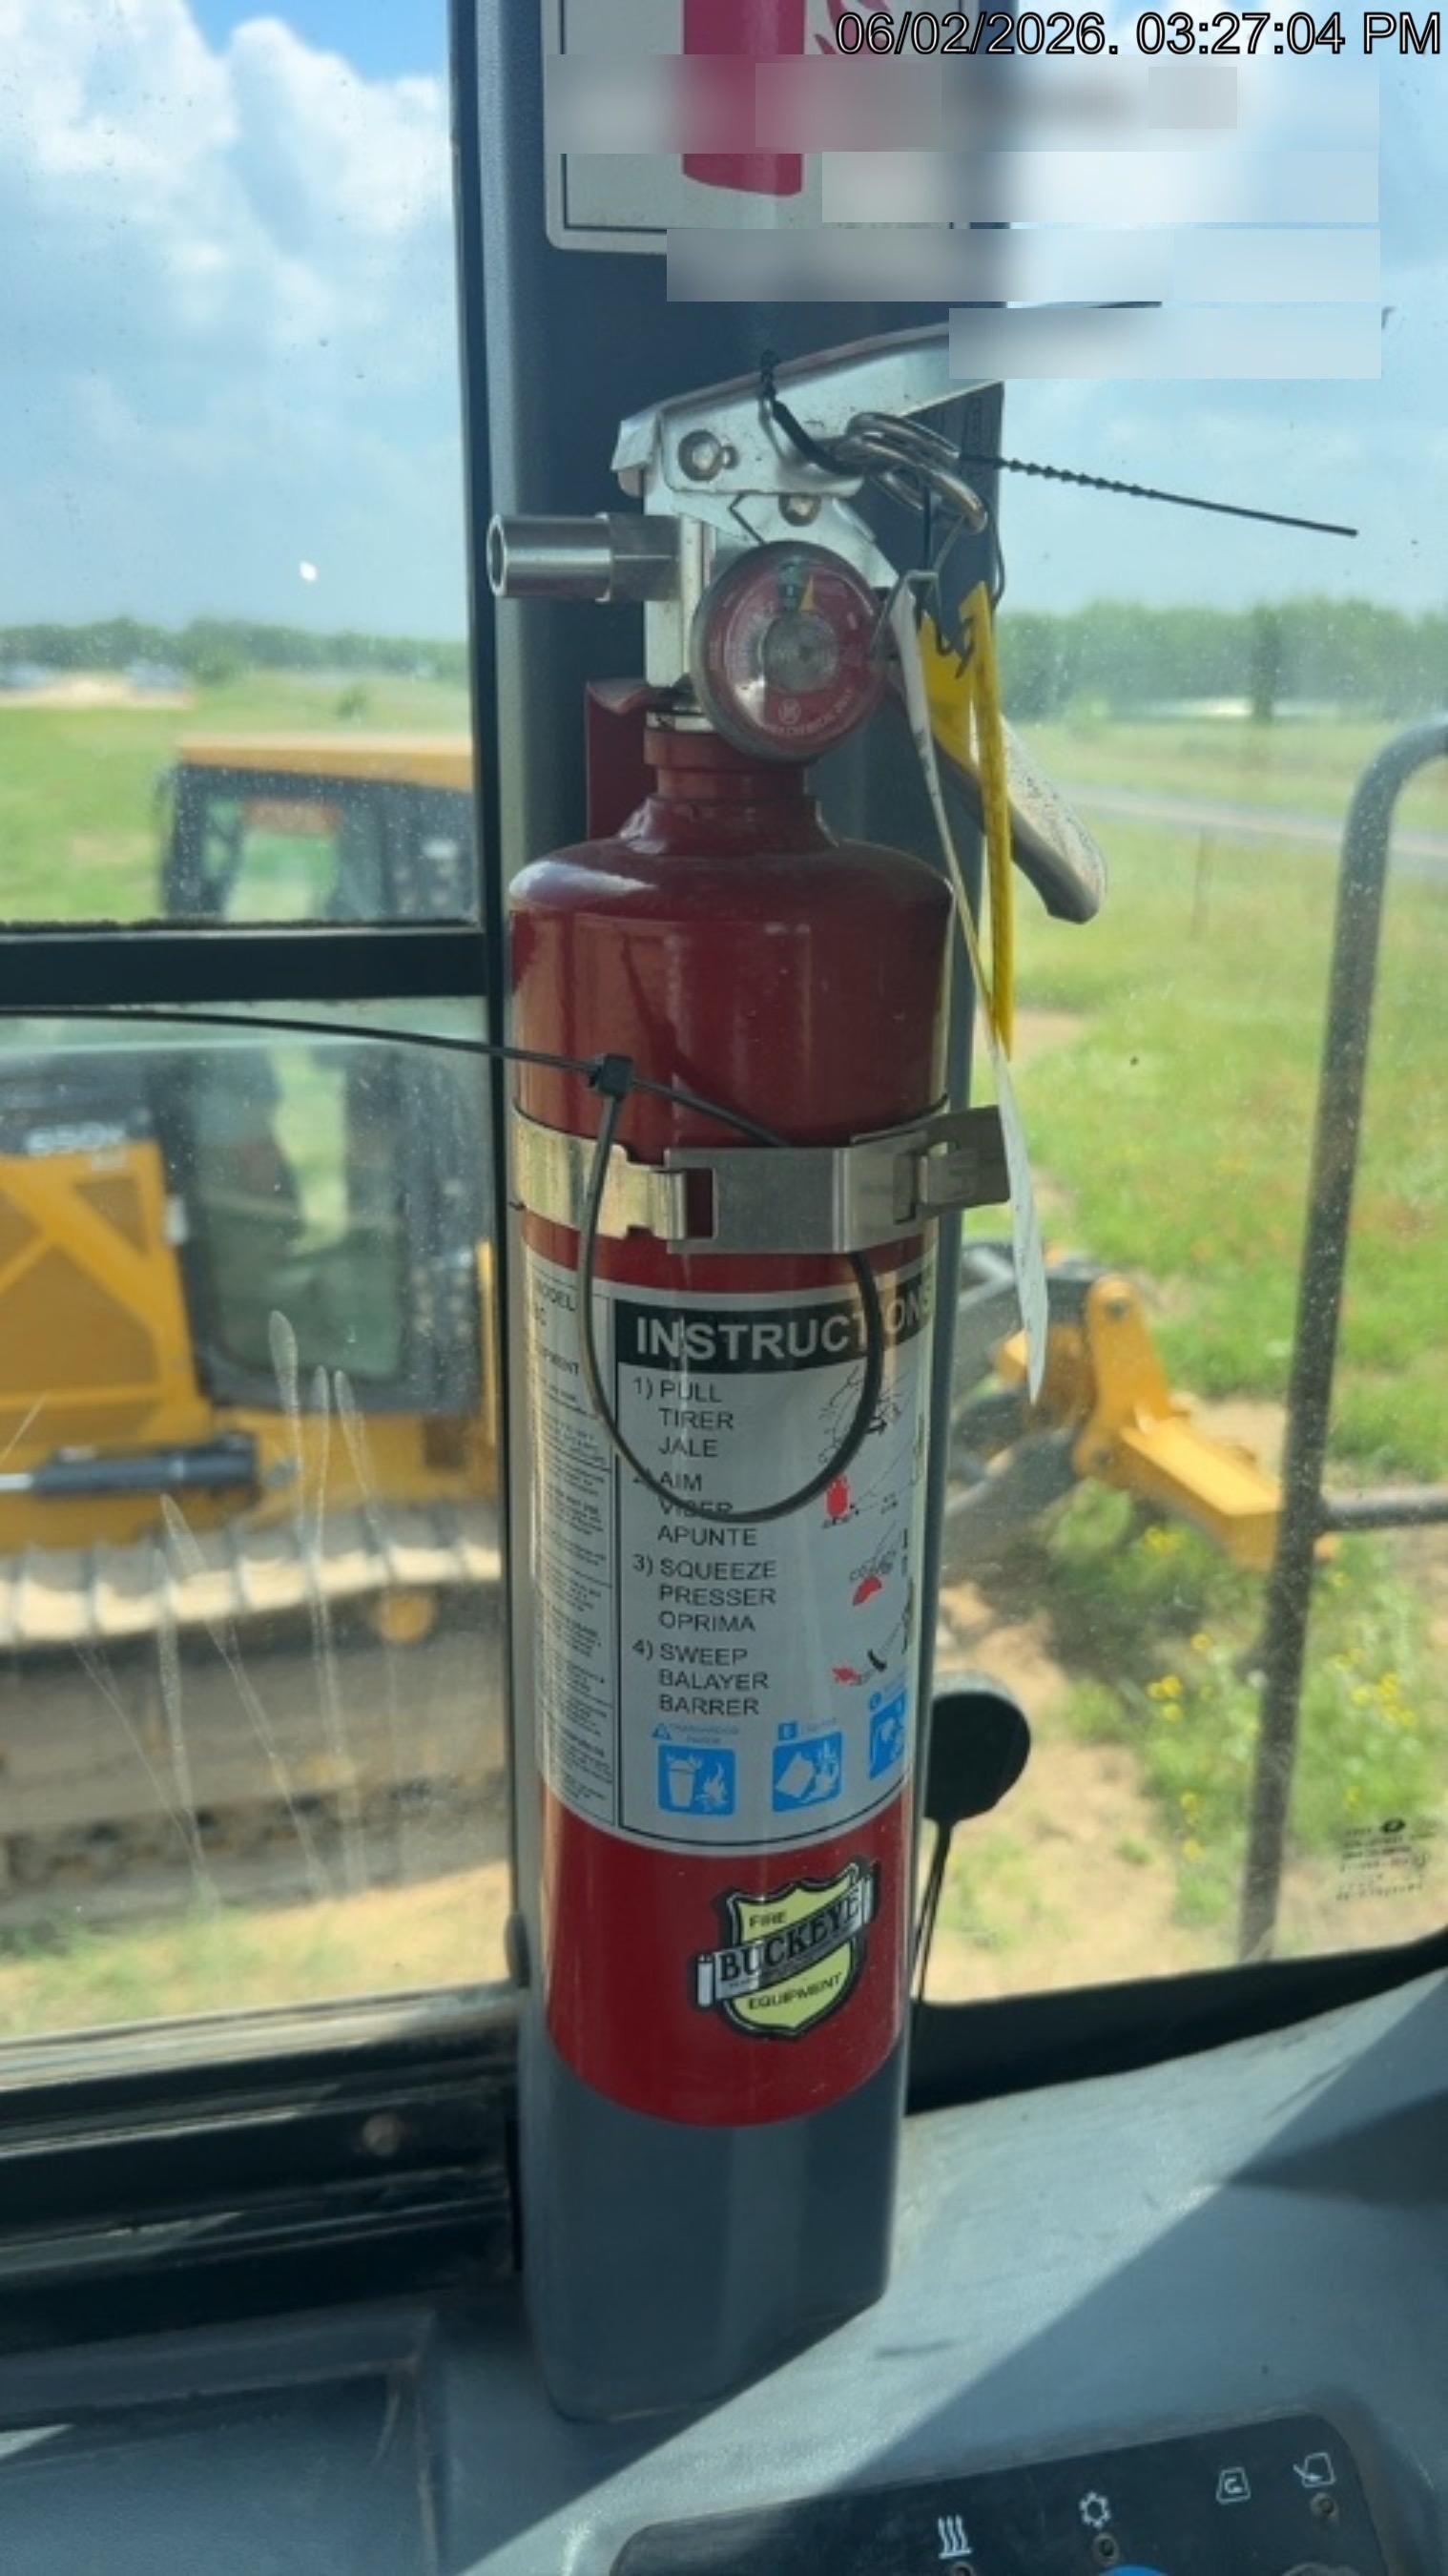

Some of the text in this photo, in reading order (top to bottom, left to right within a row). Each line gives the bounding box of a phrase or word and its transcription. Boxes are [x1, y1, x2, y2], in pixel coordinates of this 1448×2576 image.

[634, 1377, 723, 1403] 1) PULL
[659, 1408, 734, 1429] TIRER
[659, 1439, 718, 1458] JALE
[660, 1471, 703, 1492] AIM
[657, 1527, 757, 1547] APUNTE
[632, 1555, 777, 1580] 3) SQUEEZE
[660, 1586, 776, 1606] PRESSER
[658, 1611, 756, 1633] OPRIMA
[632, 1639, 748, 1666] 4) SWEEP
[659, 1669, 769, 1691] BALAYER
[659, 1694, 760, 1716] BARRER
[749, 1911, 786, 1927] FIRE
[720, 1893, 860, 1982] BUCKEYE
[749, 1970, 842, 2010] EQUIPMENT
